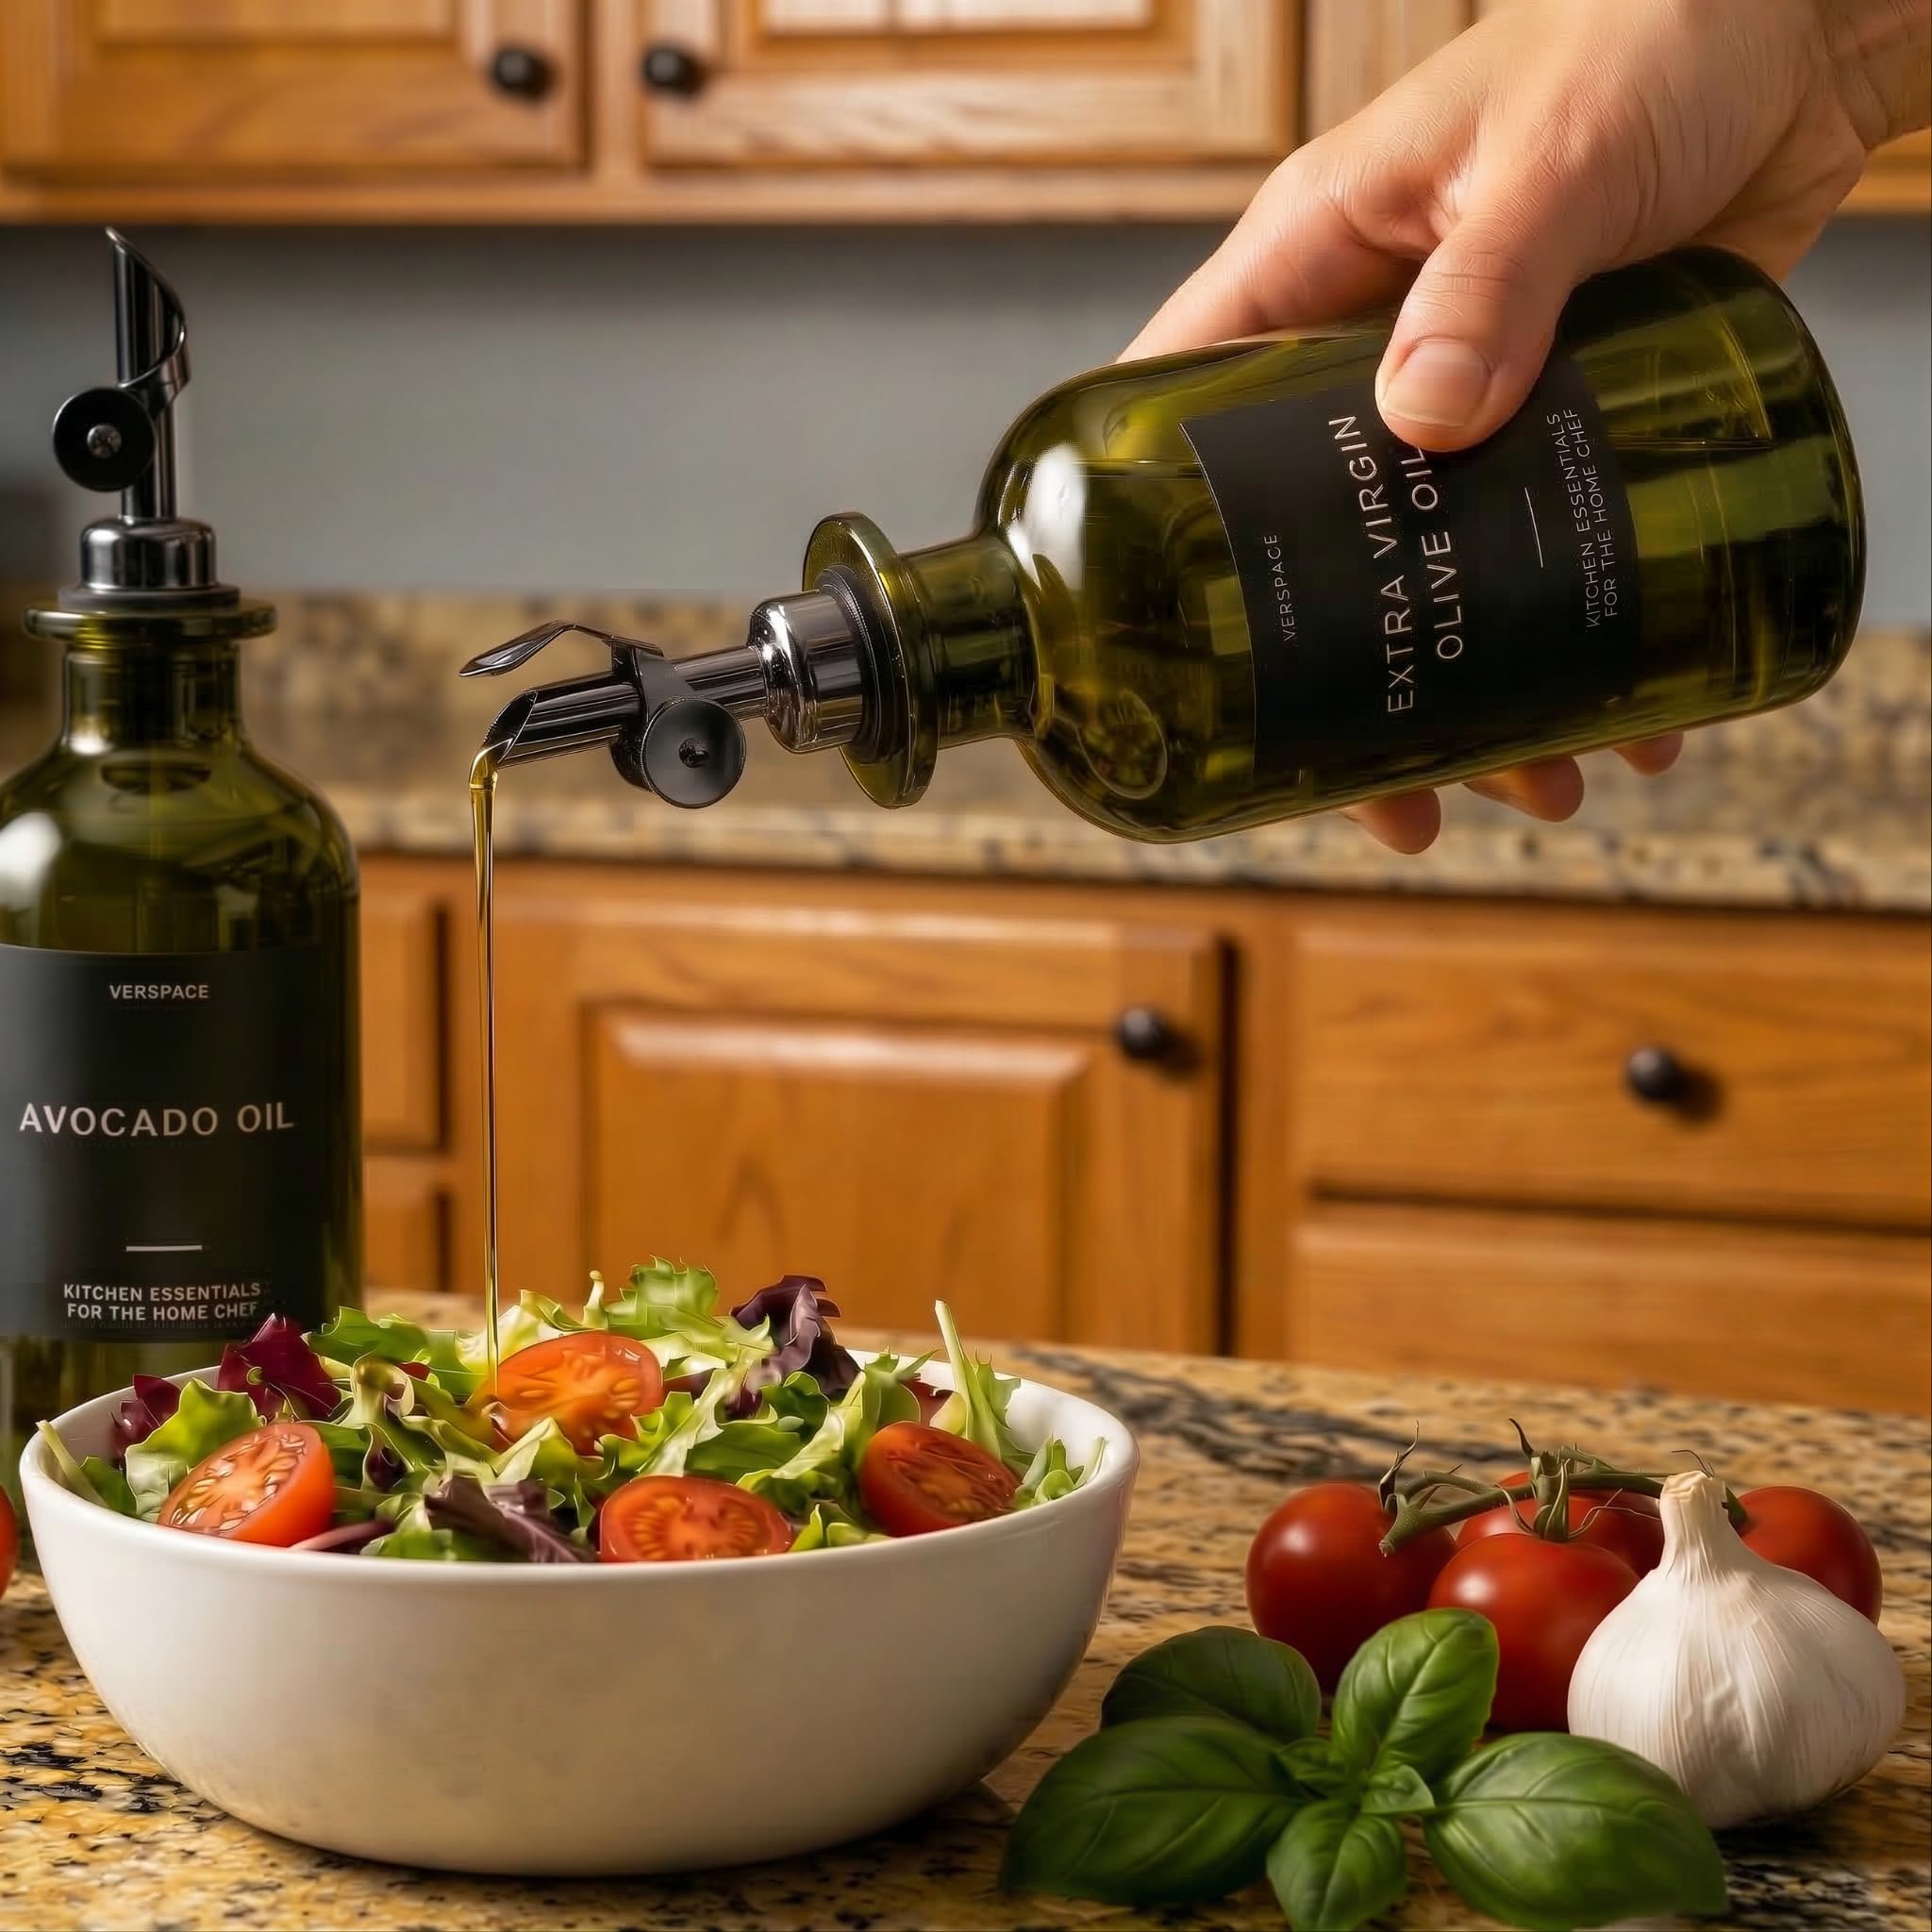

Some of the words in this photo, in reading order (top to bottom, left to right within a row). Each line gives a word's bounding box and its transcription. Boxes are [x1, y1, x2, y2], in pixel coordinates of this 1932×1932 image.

[1563, 408, 1591, 458] CHEF
[1328, 415, 1402, 558] VIRGIN
[1399, 447, 1439, 511] OIL
[1546, 412, 1591, 533] ESSENTIALS
[1582, 463, 1609, 524] HOME
[1597, 526, 1616, 573] THE
[1263, 533, 1298, 642] VERSPACE
[1420, 531, 1464, 660] OLIVE
[1580, 541, 1601, 628] KITCHEN
[1604, 576, 1620, 618] FOR
[1378, 574, 1414, 714] EXTRA
[108, 984, 210, 1000] VERSPACE
[19, 1102, 219, 1137] AVOCADO
[237, 1101, 295, 1133] OIL
[63, 1283, 142, 1301] KITCHEN
[149, 1282, 261, 1301] ESSENTIALS
[67, 1304, 102, 1320] FOR
[108, 1305, 146, 1321] THE
[153, 1305, 208, 1321] HOME
[214, 1302, 258, 1319] CHEF
